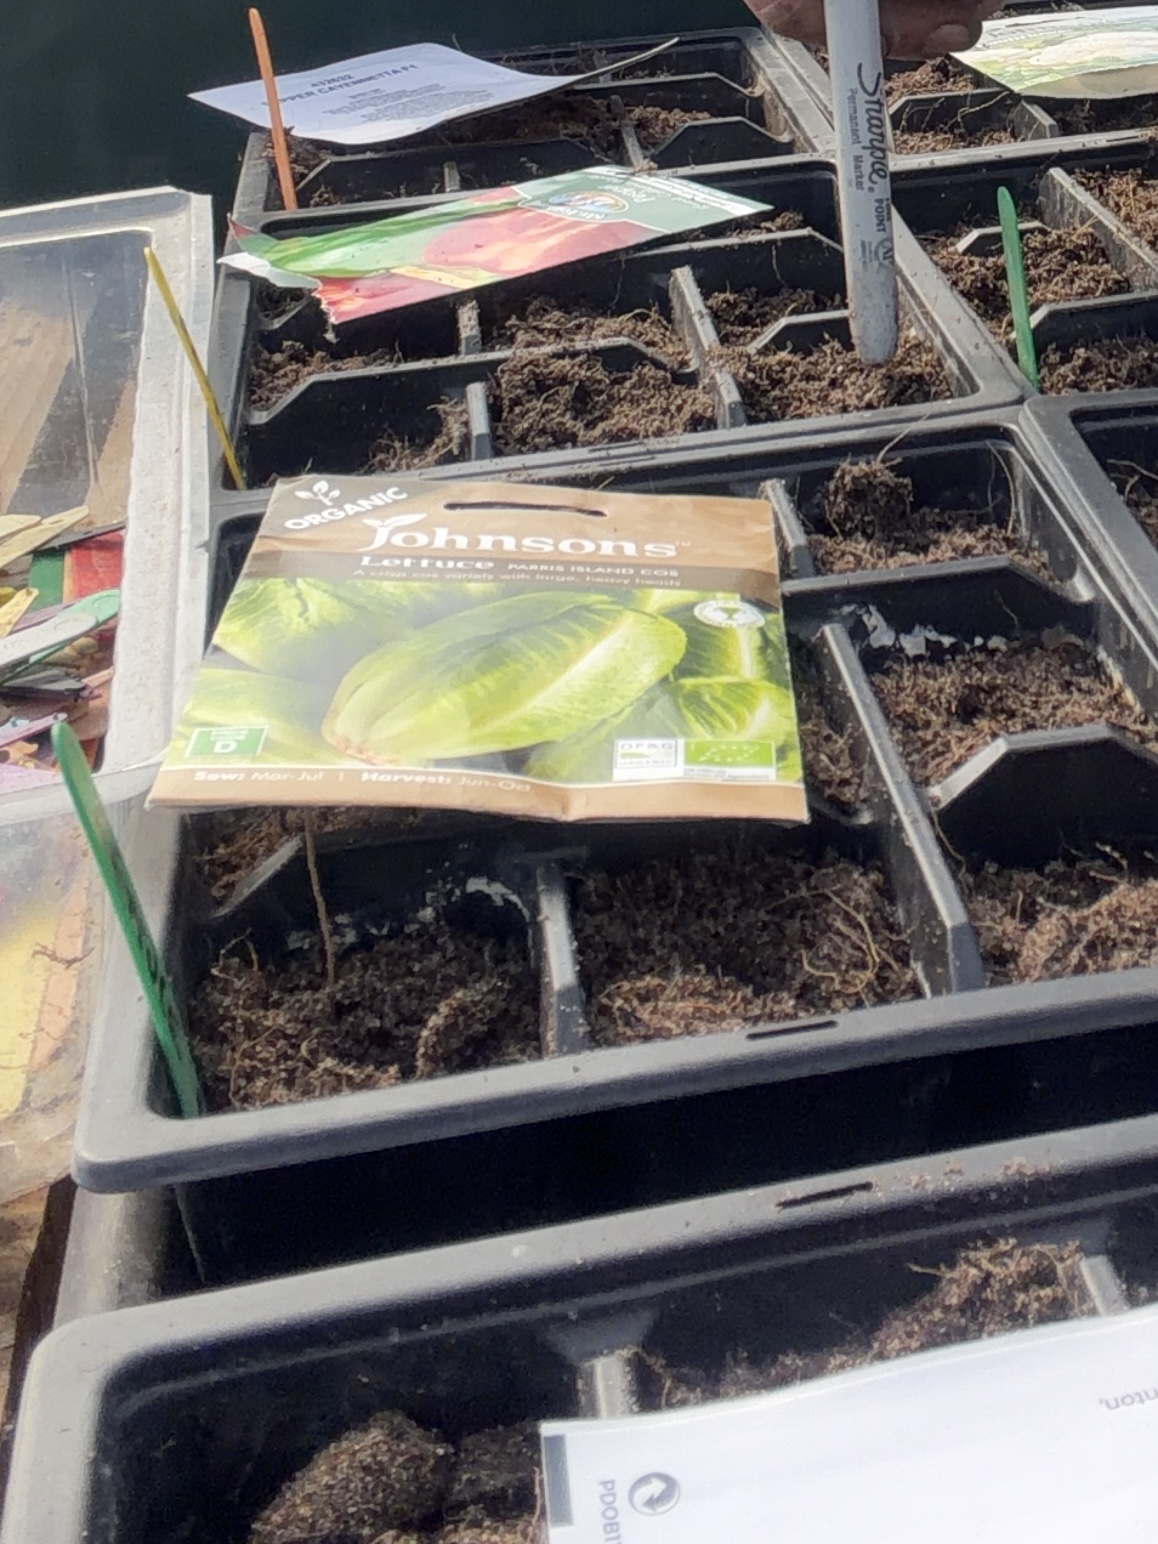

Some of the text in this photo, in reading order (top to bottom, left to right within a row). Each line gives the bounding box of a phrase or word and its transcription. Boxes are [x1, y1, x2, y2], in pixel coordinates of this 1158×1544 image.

[847, 88, 864, 191] Permanent Marker
[283, 487, 409, 529] ORGANIC
[355, 514, 677, 558] Johnsons
[360, 556, 679, 577] Lettuce PARRIS ISLAND COS
[444, 572, 495, 580] variety
[213, 741, 237, 753] D
[193, 771, 245, 781] Sow:
[251, 771, 325, 782] Mar-Jul
[361, 771, 451, 784] Harvest:
